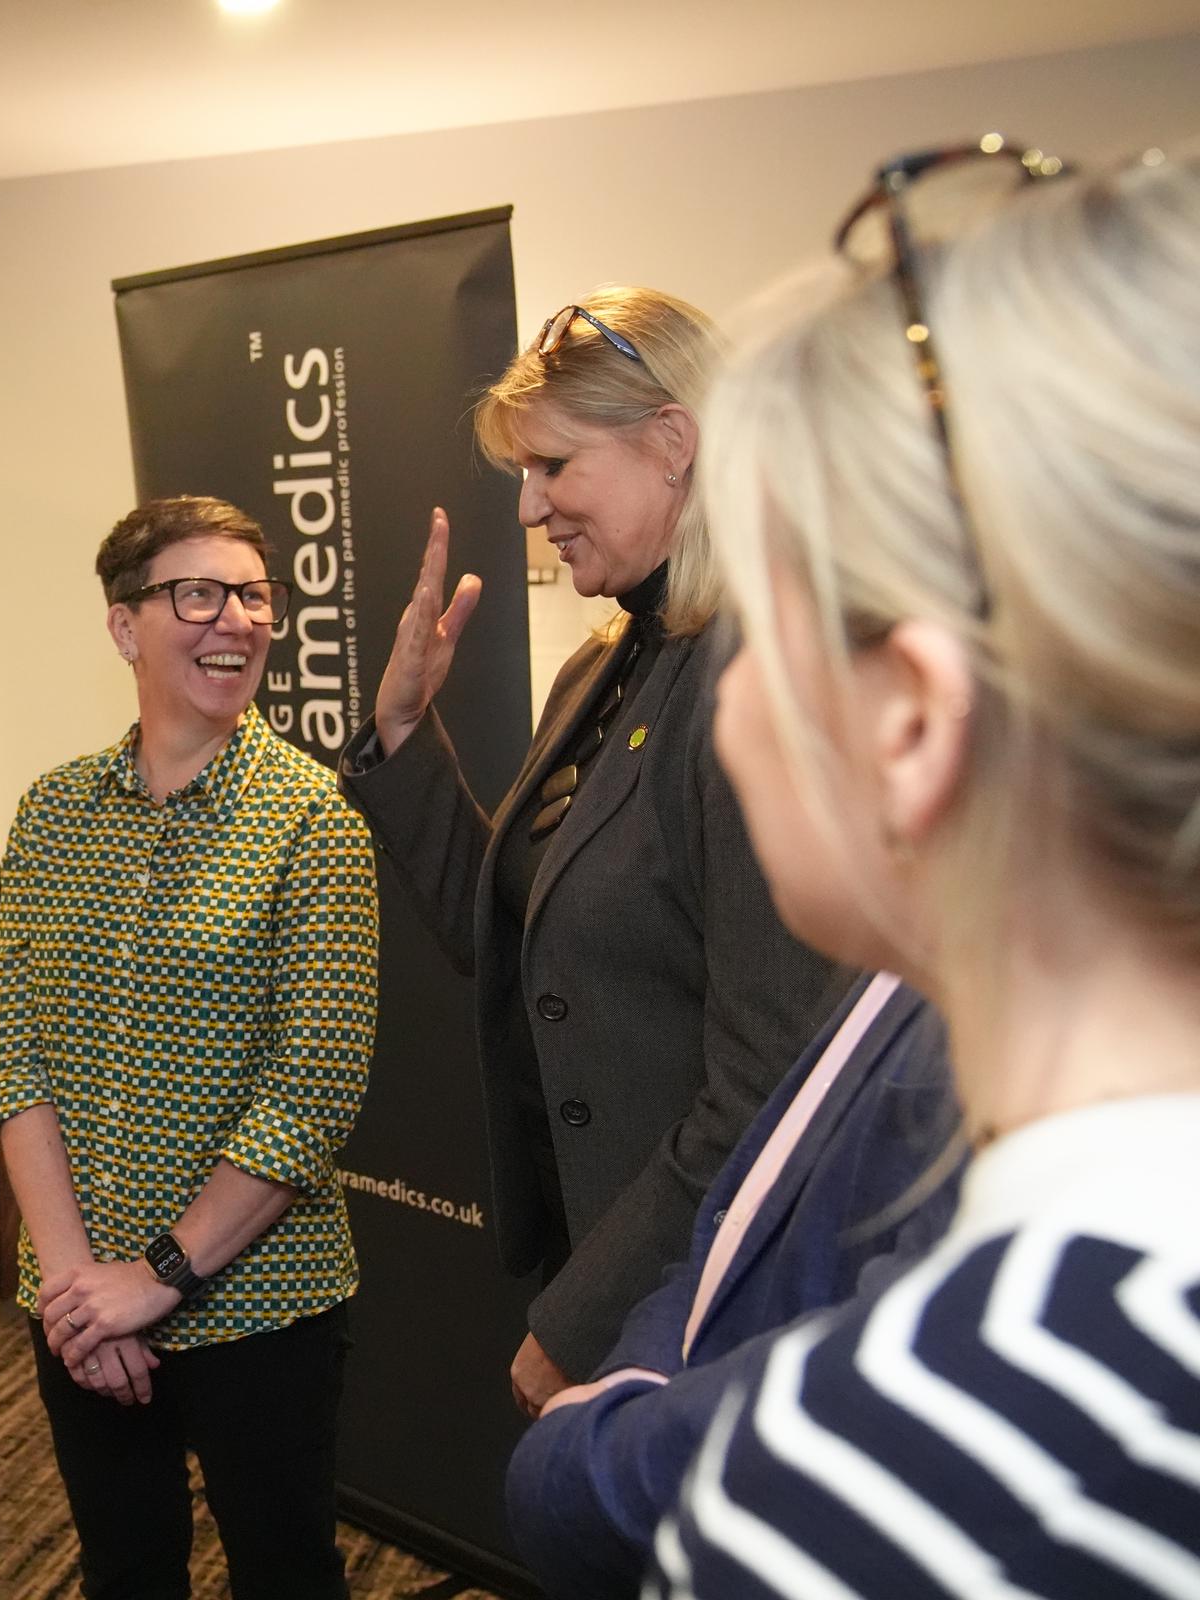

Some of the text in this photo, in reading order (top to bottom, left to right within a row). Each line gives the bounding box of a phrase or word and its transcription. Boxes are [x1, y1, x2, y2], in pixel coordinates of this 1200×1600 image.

[249, 331, 263, 363] TM
[273, 347, 345, 750] amedics
[333, 347, 361, 735] velopment of the paramedic profession
[267, 670, 294, 734] GE
